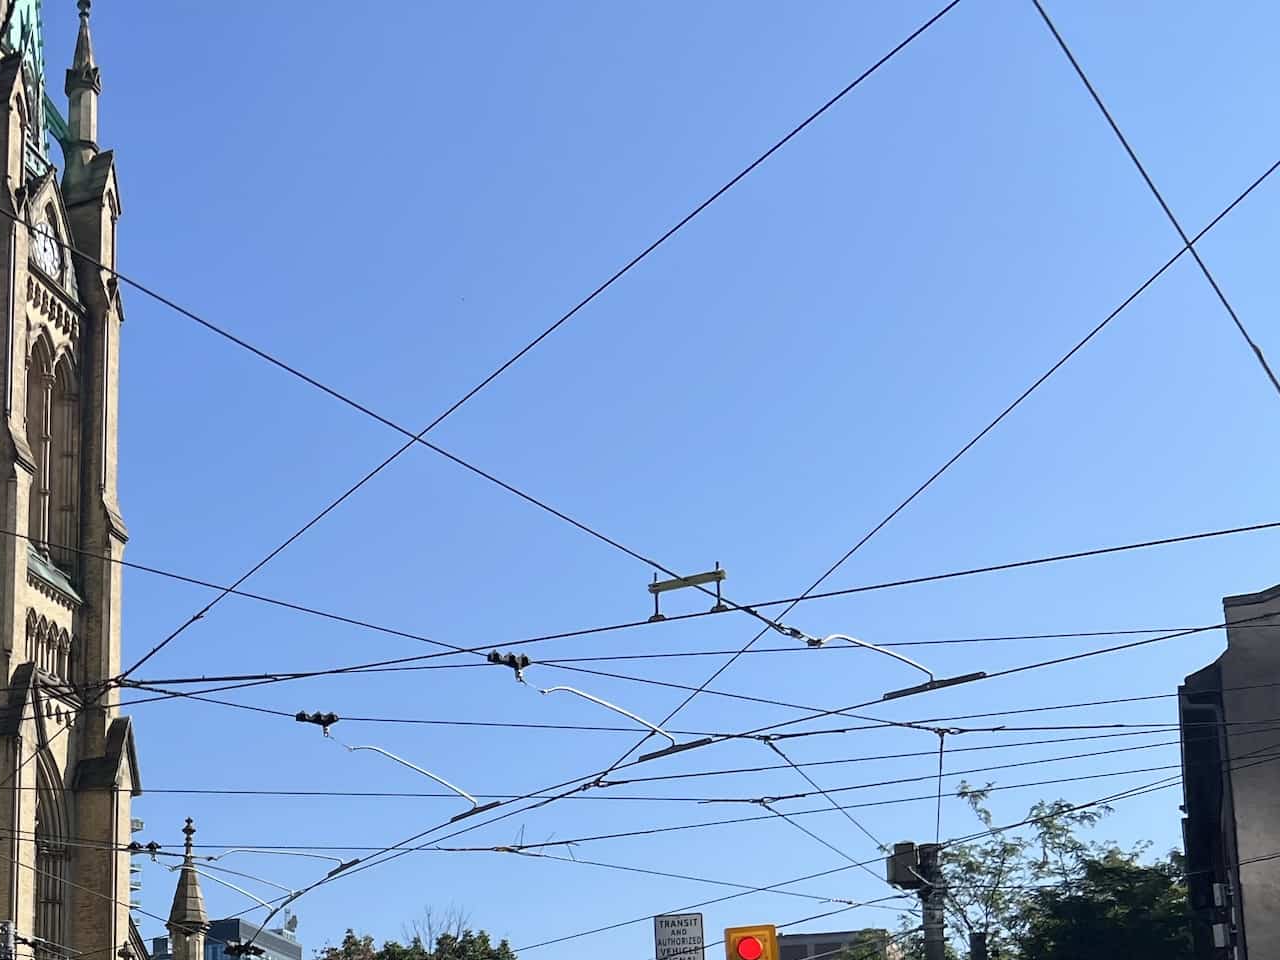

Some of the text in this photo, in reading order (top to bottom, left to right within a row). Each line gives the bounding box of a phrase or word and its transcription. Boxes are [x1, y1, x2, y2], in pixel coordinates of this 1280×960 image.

[659, 918, 697, 928] TRANSIT
[658, 936, 702, 946] AUTHORIZED
[660, 946, 699, 956] VEHICLE
